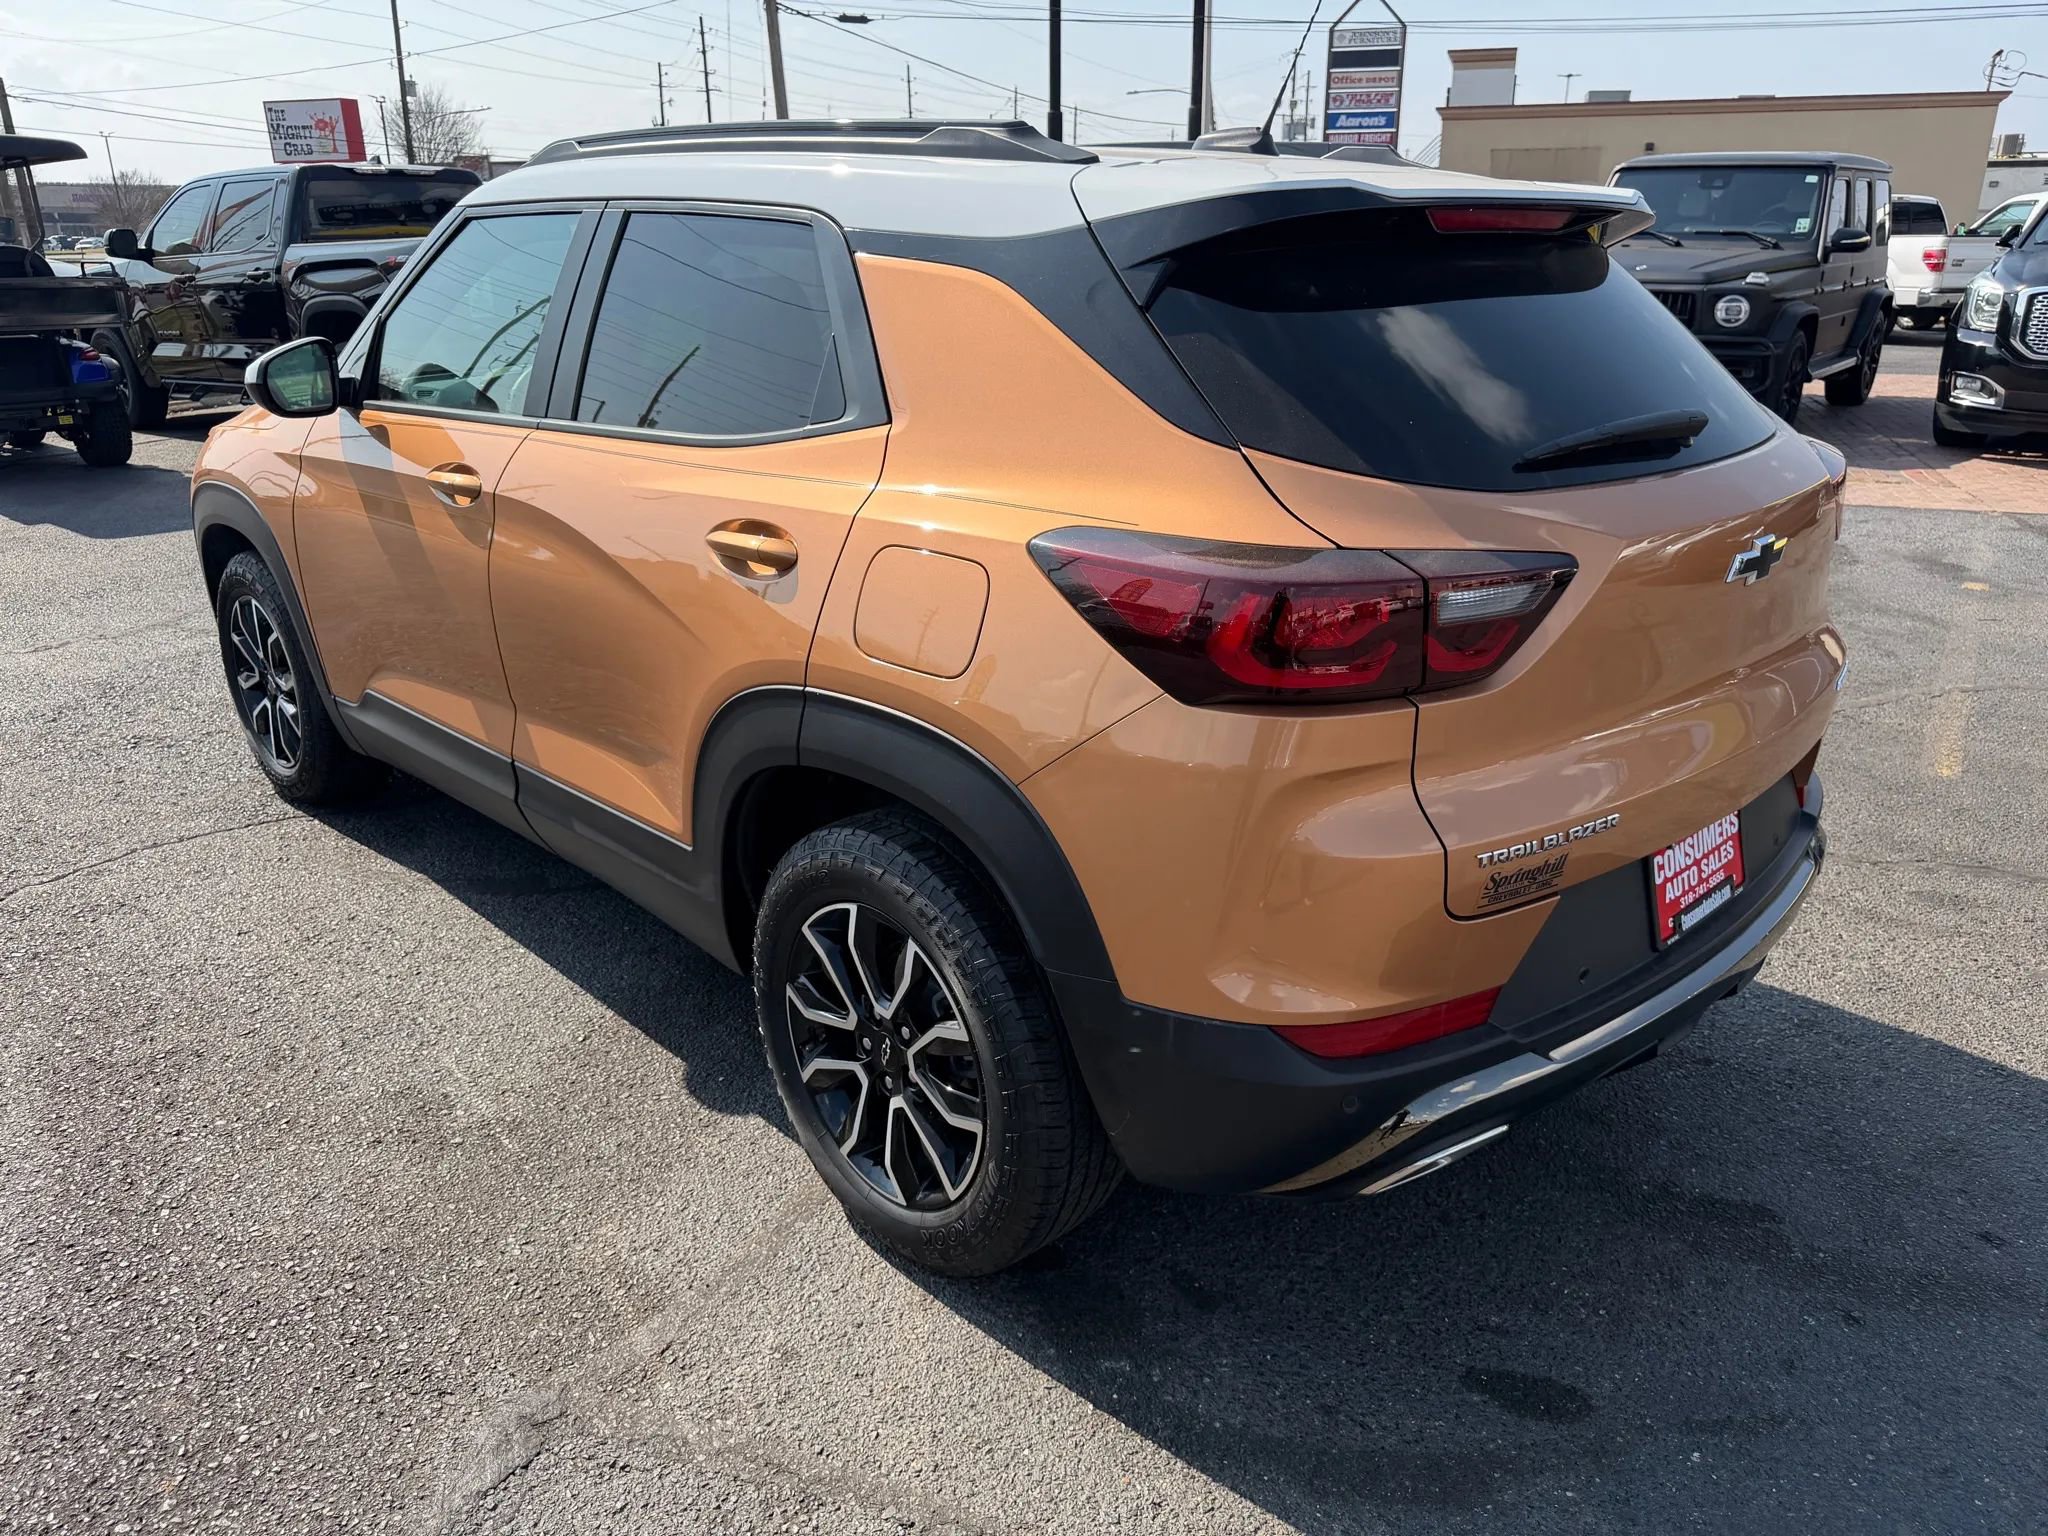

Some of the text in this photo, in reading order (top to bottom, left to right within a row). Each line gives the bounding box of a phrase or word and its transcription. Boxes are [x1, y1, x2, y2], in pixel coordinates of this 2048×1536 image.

[1332, 76, 1395, 84] Office DEPOT
[267, 107, 287, 122] THE
[1335, 114, 1387, 127] Aaron's
[270, 123, 313, 141] MIGHTY
[283, 142, 314, 157] CRAB
[1476, 813, 1620, 868] TRAILBLAZER
[1653, 812, 1739, 885] CONSUMERS
[1484, 853, 1569, 893] Springhill
[1665, 840, 1735, 904] AUTO SALES
